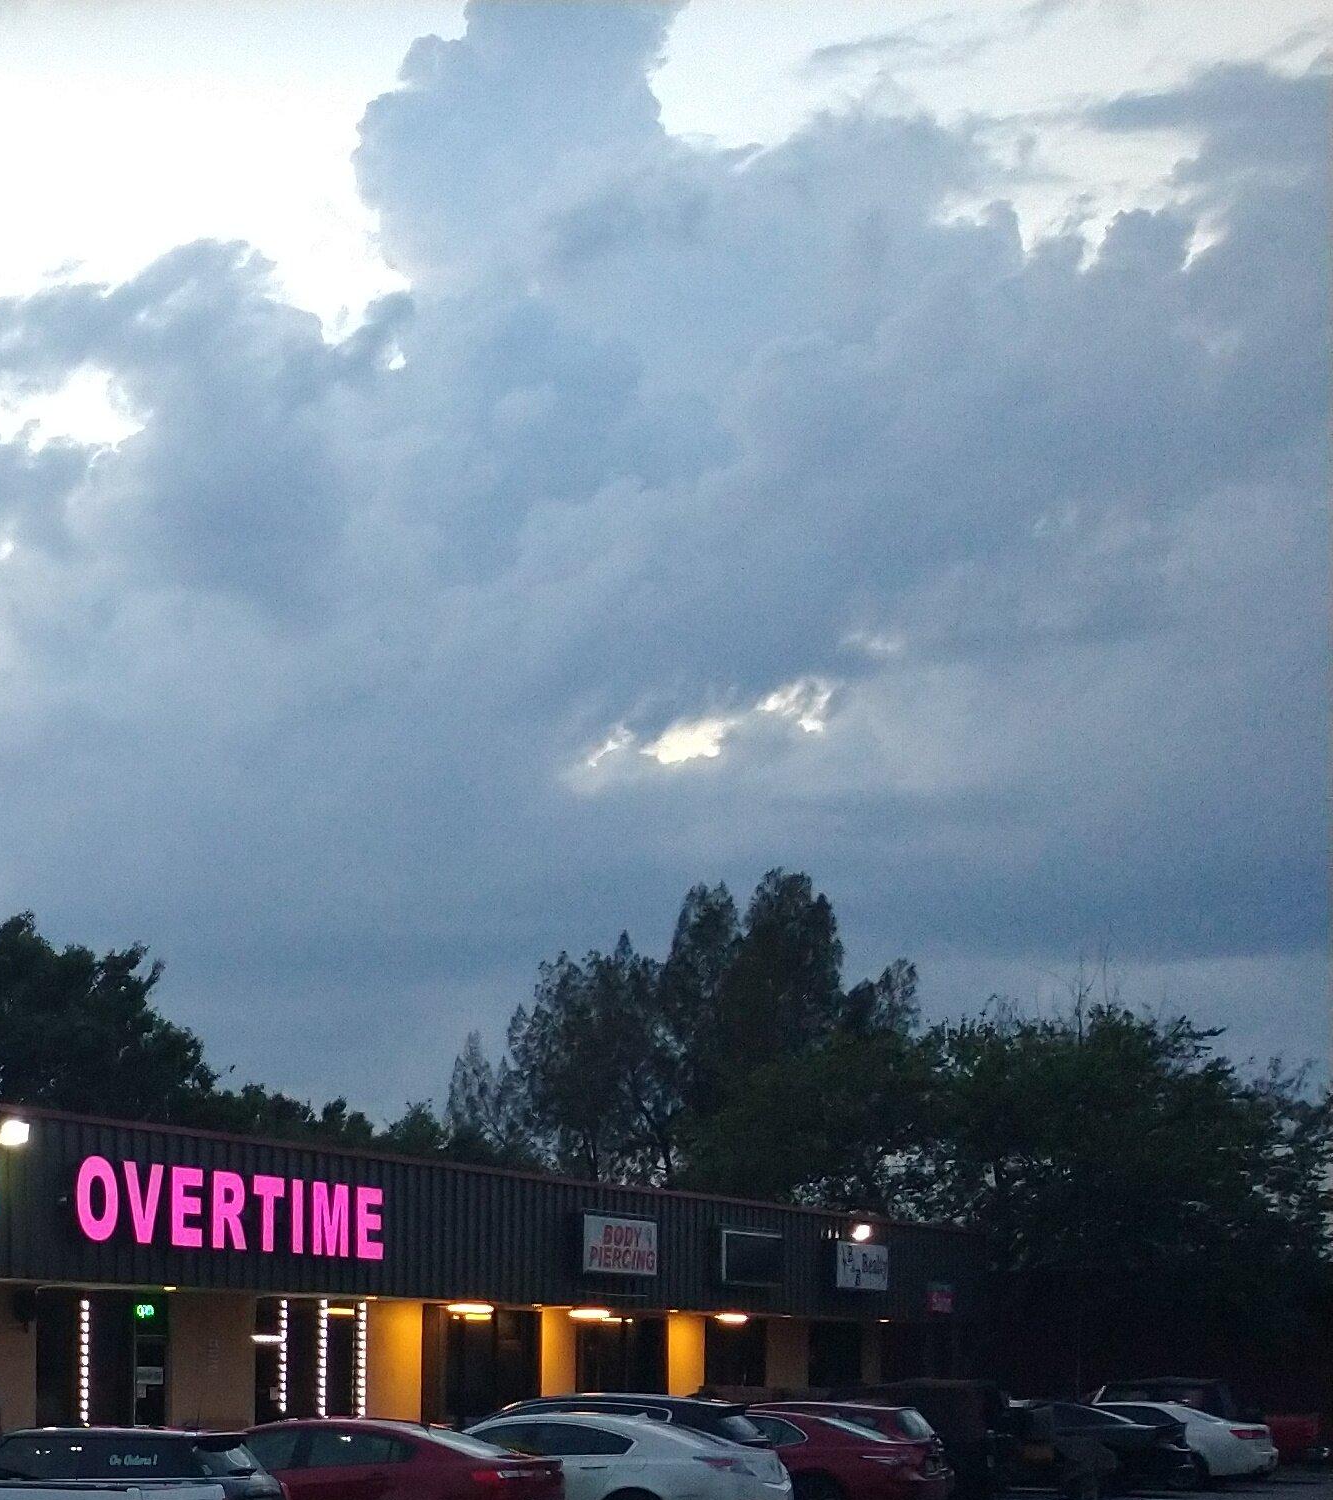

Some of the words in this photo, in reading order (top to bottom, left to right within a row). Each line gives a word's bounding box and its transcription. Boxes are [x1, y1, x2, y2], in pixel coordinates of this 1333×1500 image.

[75, 1154, 385, 1261] OVERTIME
[603, 1224, 642, 1247] BODY
[589, 1245, 656, 1271] PIERCING
